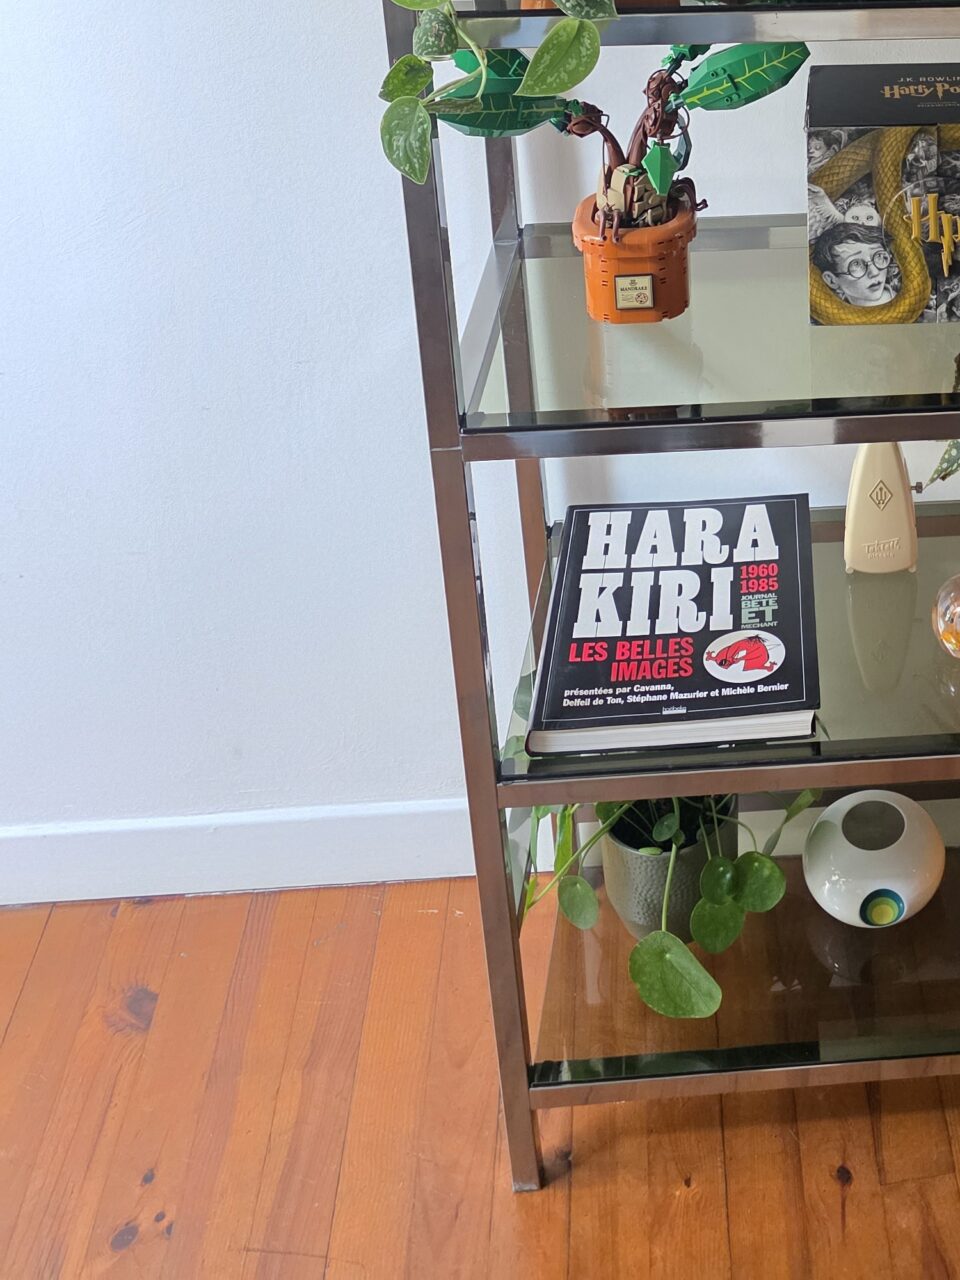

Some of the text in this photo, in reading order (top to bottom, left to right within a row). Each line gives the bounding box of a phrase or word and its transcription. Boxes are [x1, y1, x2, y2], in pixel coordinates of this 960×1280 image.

[880, 84, 934, 99] Harry
[581, 504, 779, 570] HARA
[740, 563, 778, 579] 1960
[740, 577, 778, 593] 1985
[572, 566, 734, 639] KIRI
[741, 592, 778, 600] JOURNAL
[741, 606, 778, 624] ET
[568, 637, 694, 662] LES BELLES
[610, 658, 694, 682] IMAGES
[564, 683, 674, 697] présentées par Cavanna,
[593, 698, 603, 706] de
[606, 696, 624, 705] Ton,
[627, 693, 667, 703] Stéphane
[710, 689, 719, 697] et
[721, 686, 755, 696] Michèle
[757, 683, 789, 693] Bernier
